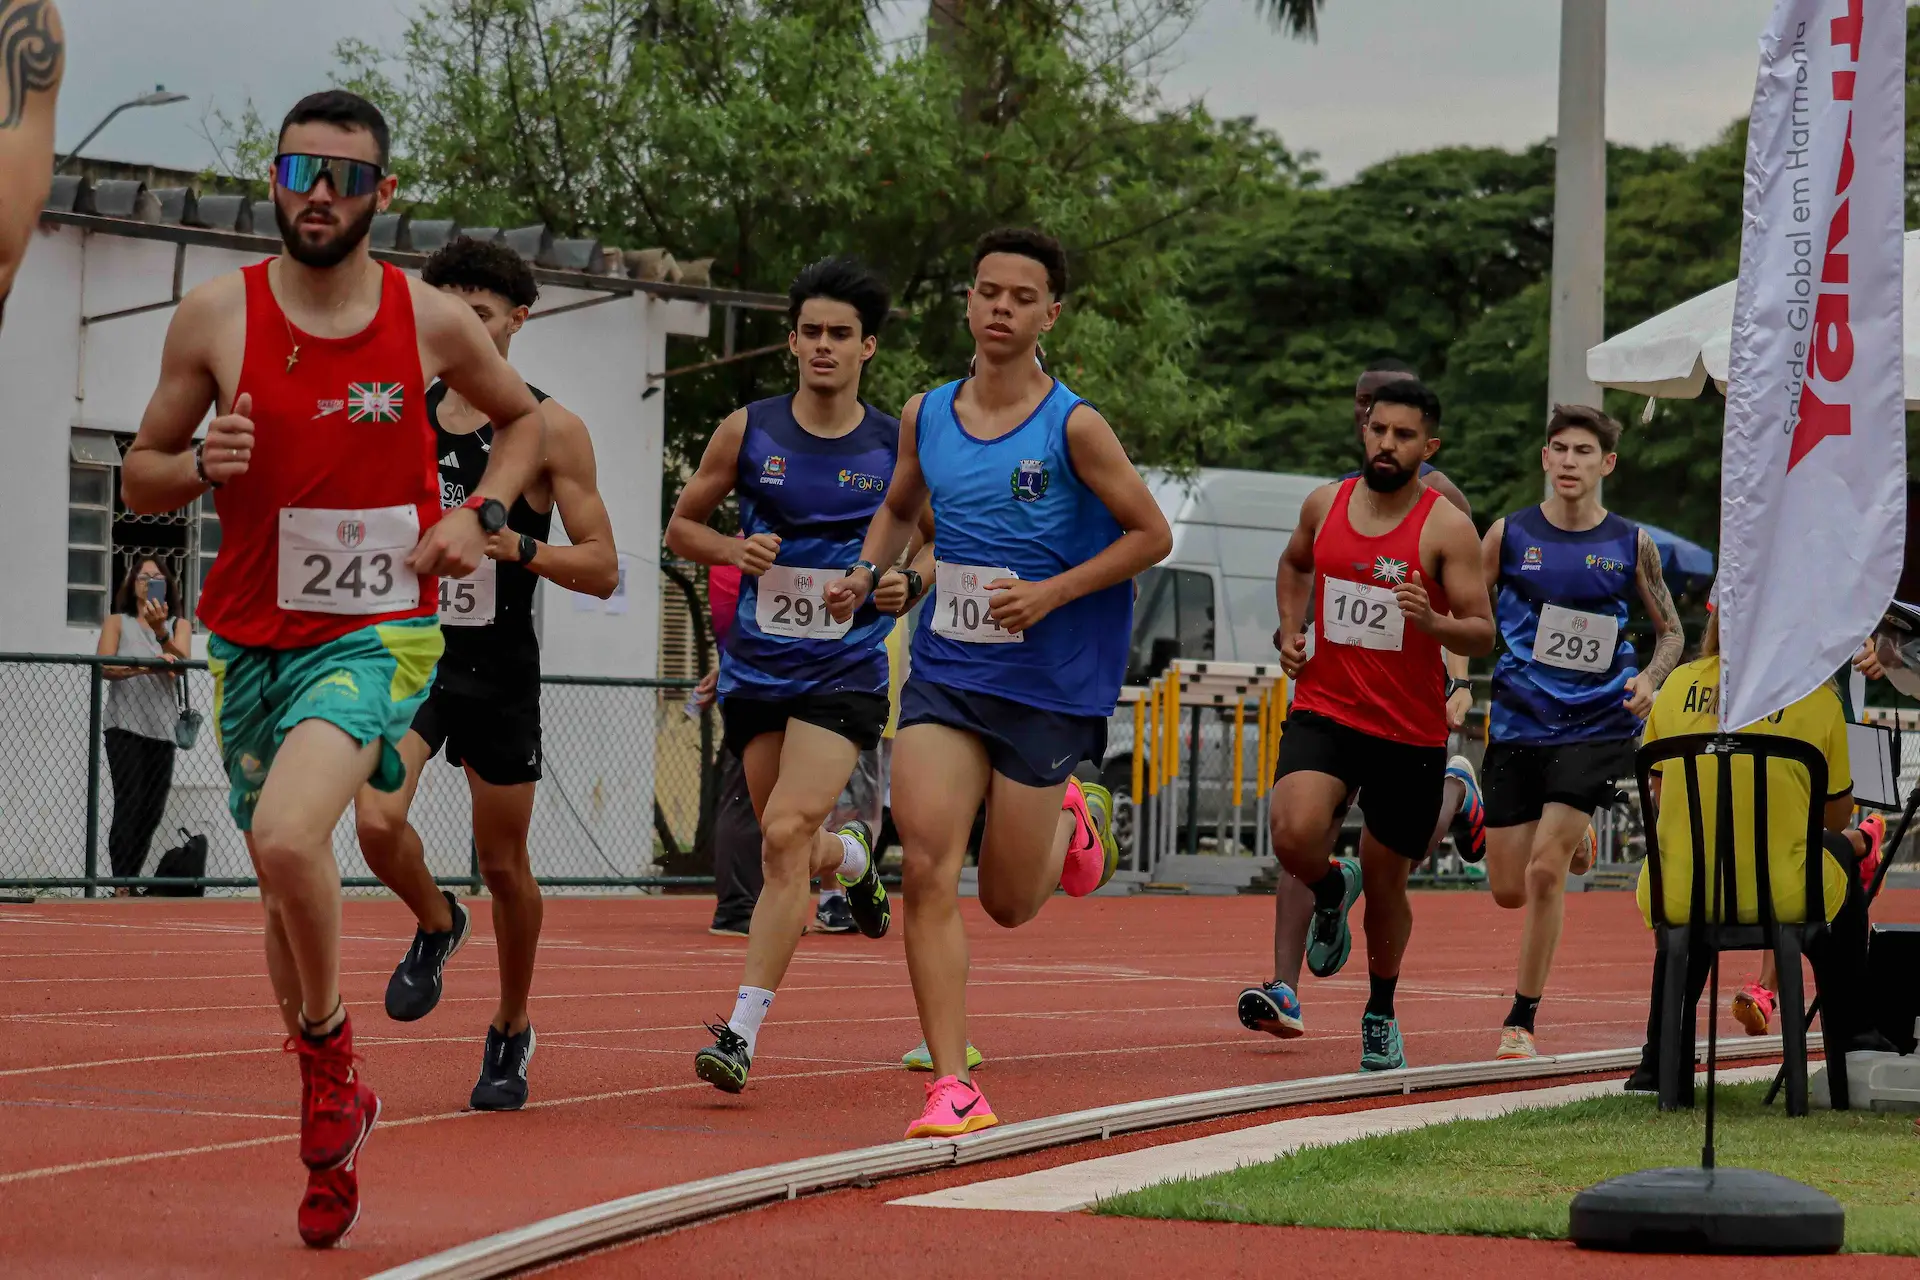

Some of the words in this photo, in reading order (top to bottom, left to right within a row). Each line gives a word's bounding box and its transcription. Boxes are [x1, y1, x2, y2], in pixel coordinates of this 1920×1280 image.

[1785, 21, 1810, 170] Harmonia
[1792, 177, 1811, 223] em
[1785, 231, 1812, 332] Global
[1783, 340, 1806, 435] Saúde
[302, 553, 394, 598] 243
[771, 594, 831, 627] 291
[948, 596, 1001, 631] 104
[1334, 594, 1388, 630] 102
[1545, 632, 1601, 663] 293
